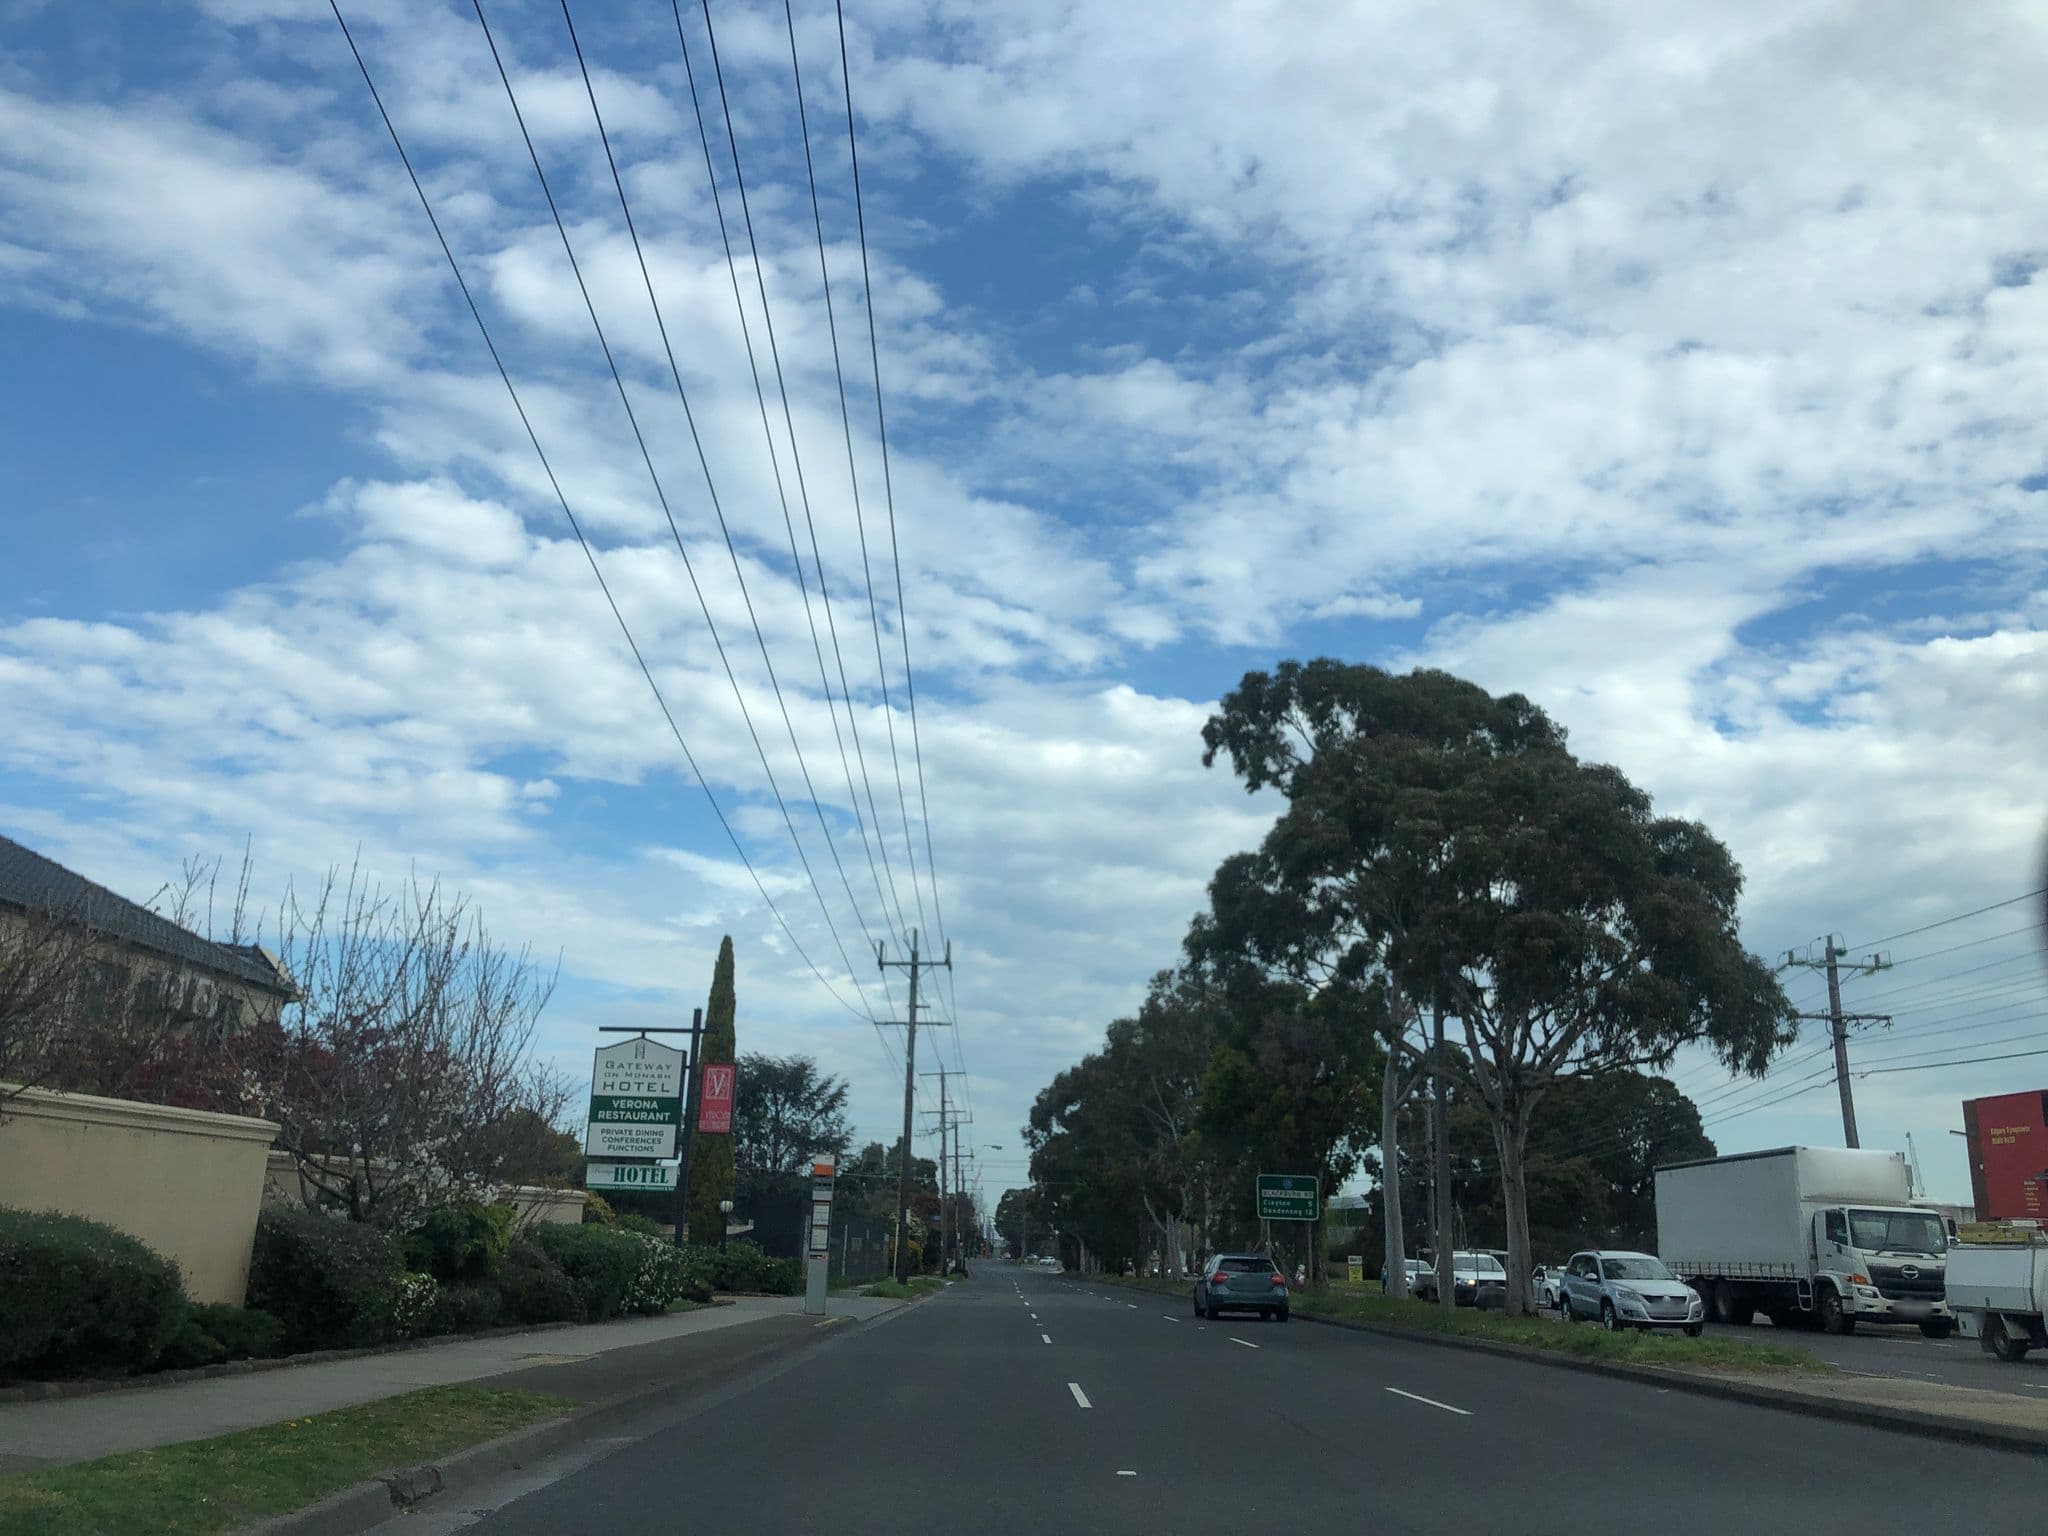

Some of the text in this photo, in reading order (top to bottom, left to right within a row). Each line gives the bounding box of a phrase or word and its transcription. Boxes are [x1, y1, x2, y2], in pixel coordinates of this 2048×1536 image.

[605, 1061, 672, 1071] GATEWAY
[603, 1081, 670, 1093] HOTEL
[612, 1099, 659, 1109] VERONA
[598, 1110, 671, 1121] RESTAURANT
[600, 1128, 664, 1137] PRIVATE DINING
[601, 1136, 662, 1145] CONFERENCES
[607, 1144, 655, 1152] FUNCTIONS
[613, 1166, 669, 1184] HOTEL
[1263, 1199, 1291, 1207] Clayton
[1263, 1207, 1302, 1216] Dandenong
